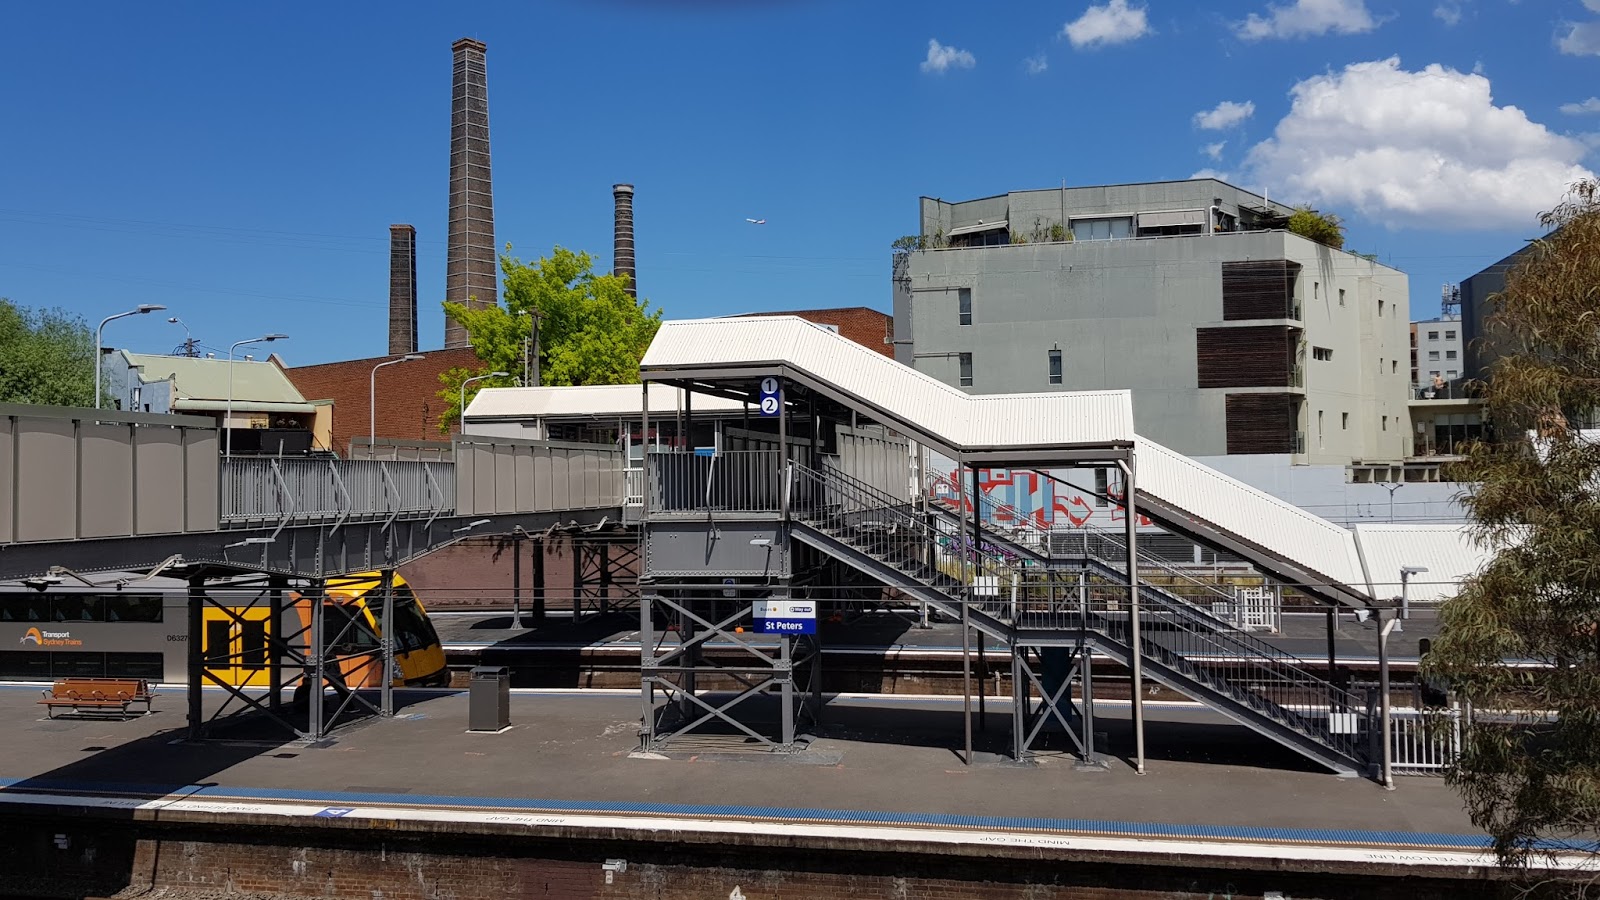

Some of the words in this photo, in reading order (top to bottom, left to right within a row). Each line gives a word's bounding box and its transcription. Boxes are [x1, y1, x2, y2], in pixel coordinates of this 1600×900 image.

[765, 379, 772, 392] 1
[765, 399, 774, 412] 2
[765, 621, 775, 630] St
[776, 621, 803, 630] Peters
[42, 630, 70, 639] Transport
[43, 639, 64, 647] Sydney
